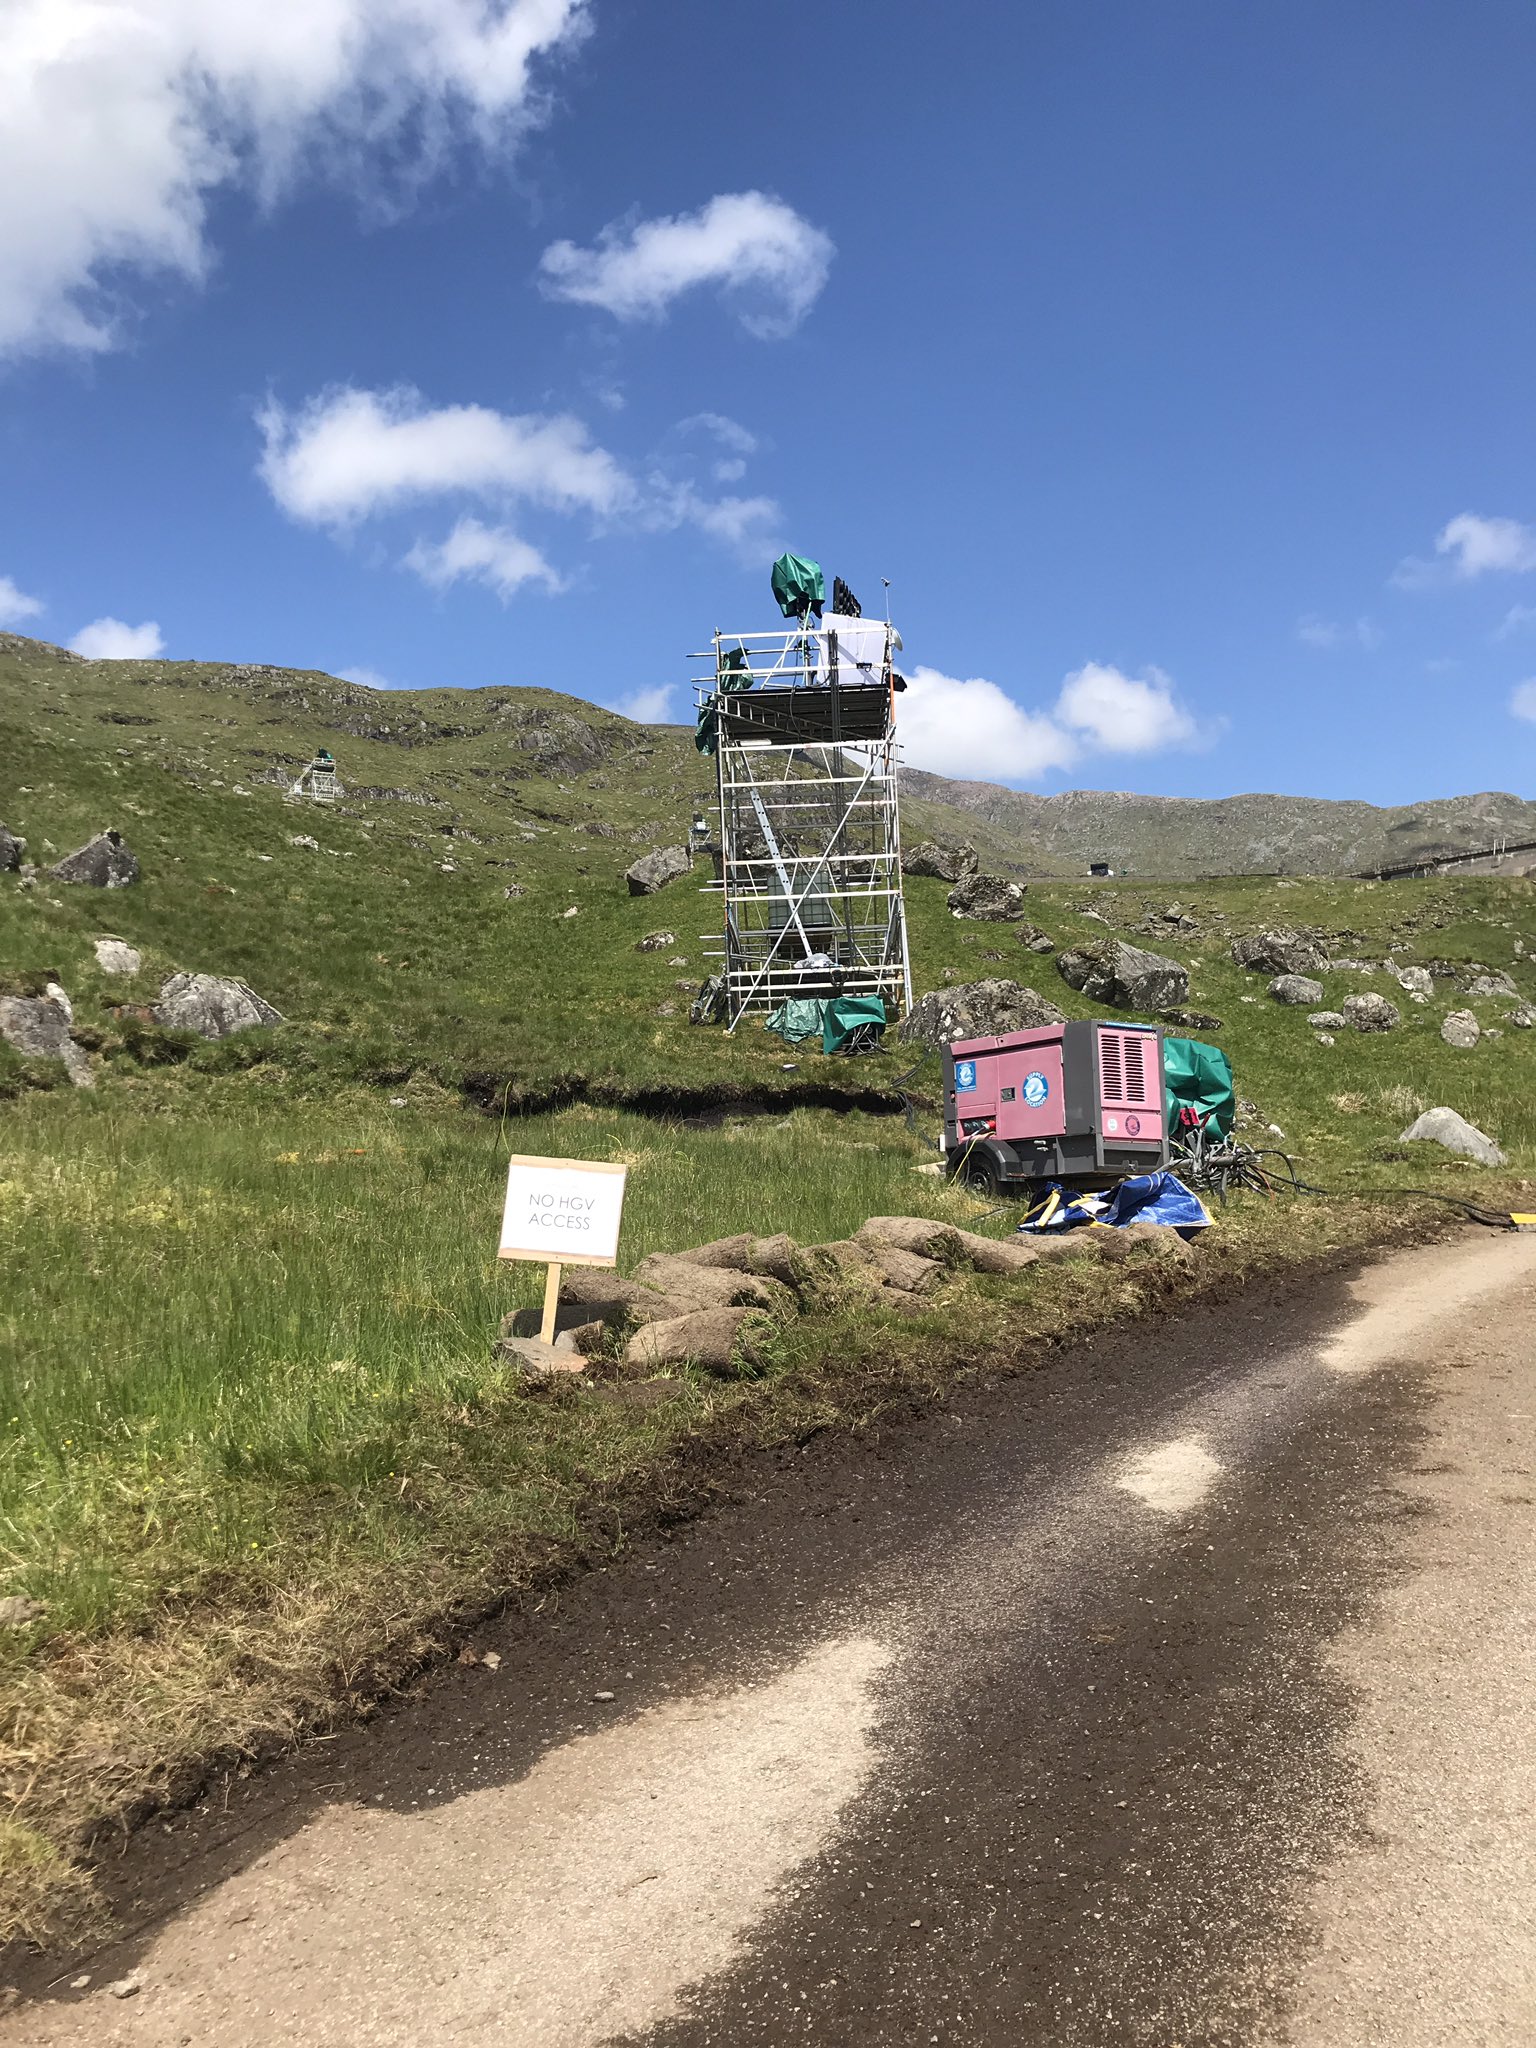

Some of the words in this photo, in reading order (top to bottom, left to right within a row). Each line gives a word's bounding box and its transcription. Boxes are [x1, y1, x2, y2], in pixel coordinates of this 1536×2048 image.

[1026, 1071, 1044, 1080] SUPPLY
[1024, 1096, 1047, 1107] LOCATION
[529, 1194, 554, 1207] NO
[559, 1196, 595, 1210] HGV
[528, 1213, 591, 1230] ACCESS
